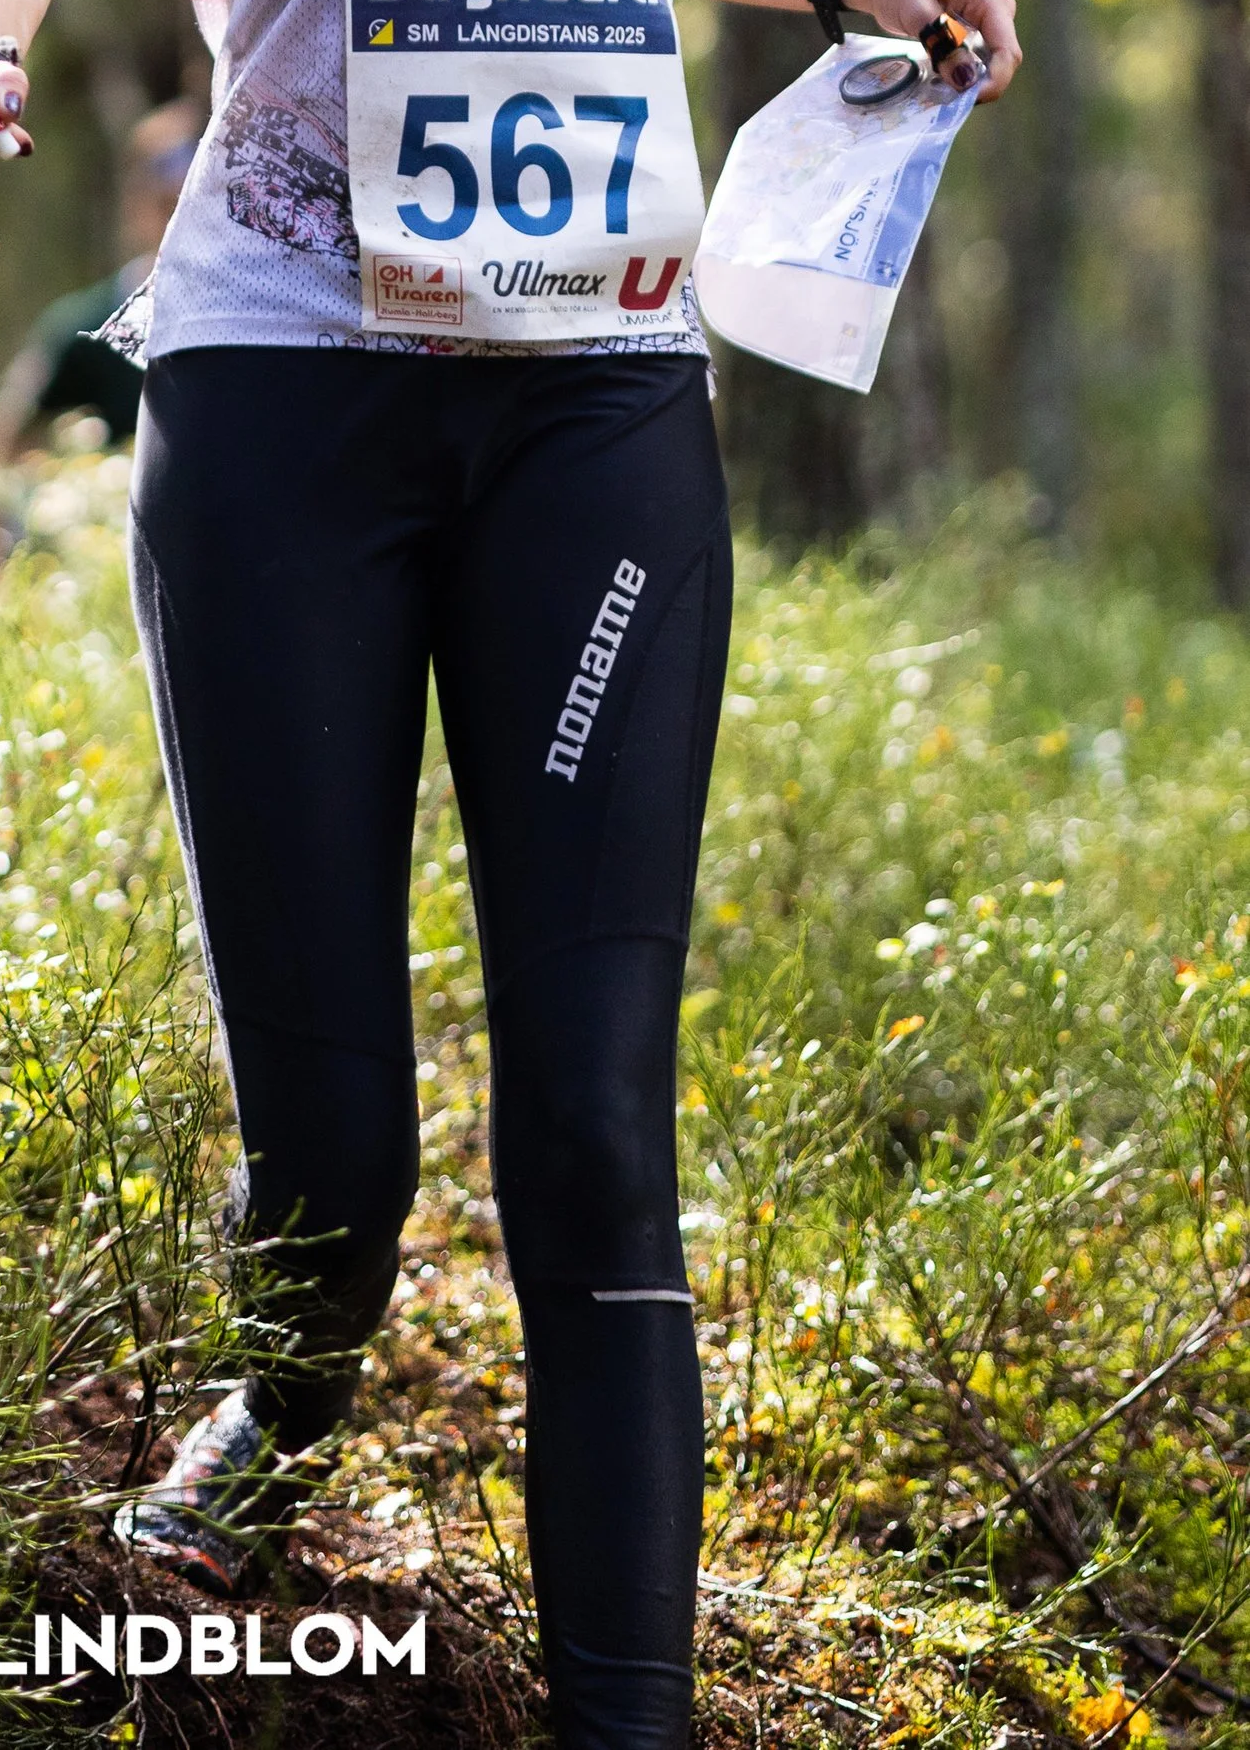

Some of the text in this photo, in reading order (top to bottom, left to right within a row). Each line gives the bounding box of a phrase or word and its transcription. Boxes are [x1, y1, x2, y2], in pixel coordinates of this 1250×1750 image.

[407, 21, 646, 45] SM LÅNGDISTANS 2025
[396, 91, 649, 241] 567
[378, 264, 414, 284] OK
[482, 259, 607, 298] Ullmax
[379, 283, 459, 303] Tisaren
[617, 313, 671, 326] UMARA
[544, 557, 647, 783] noname
